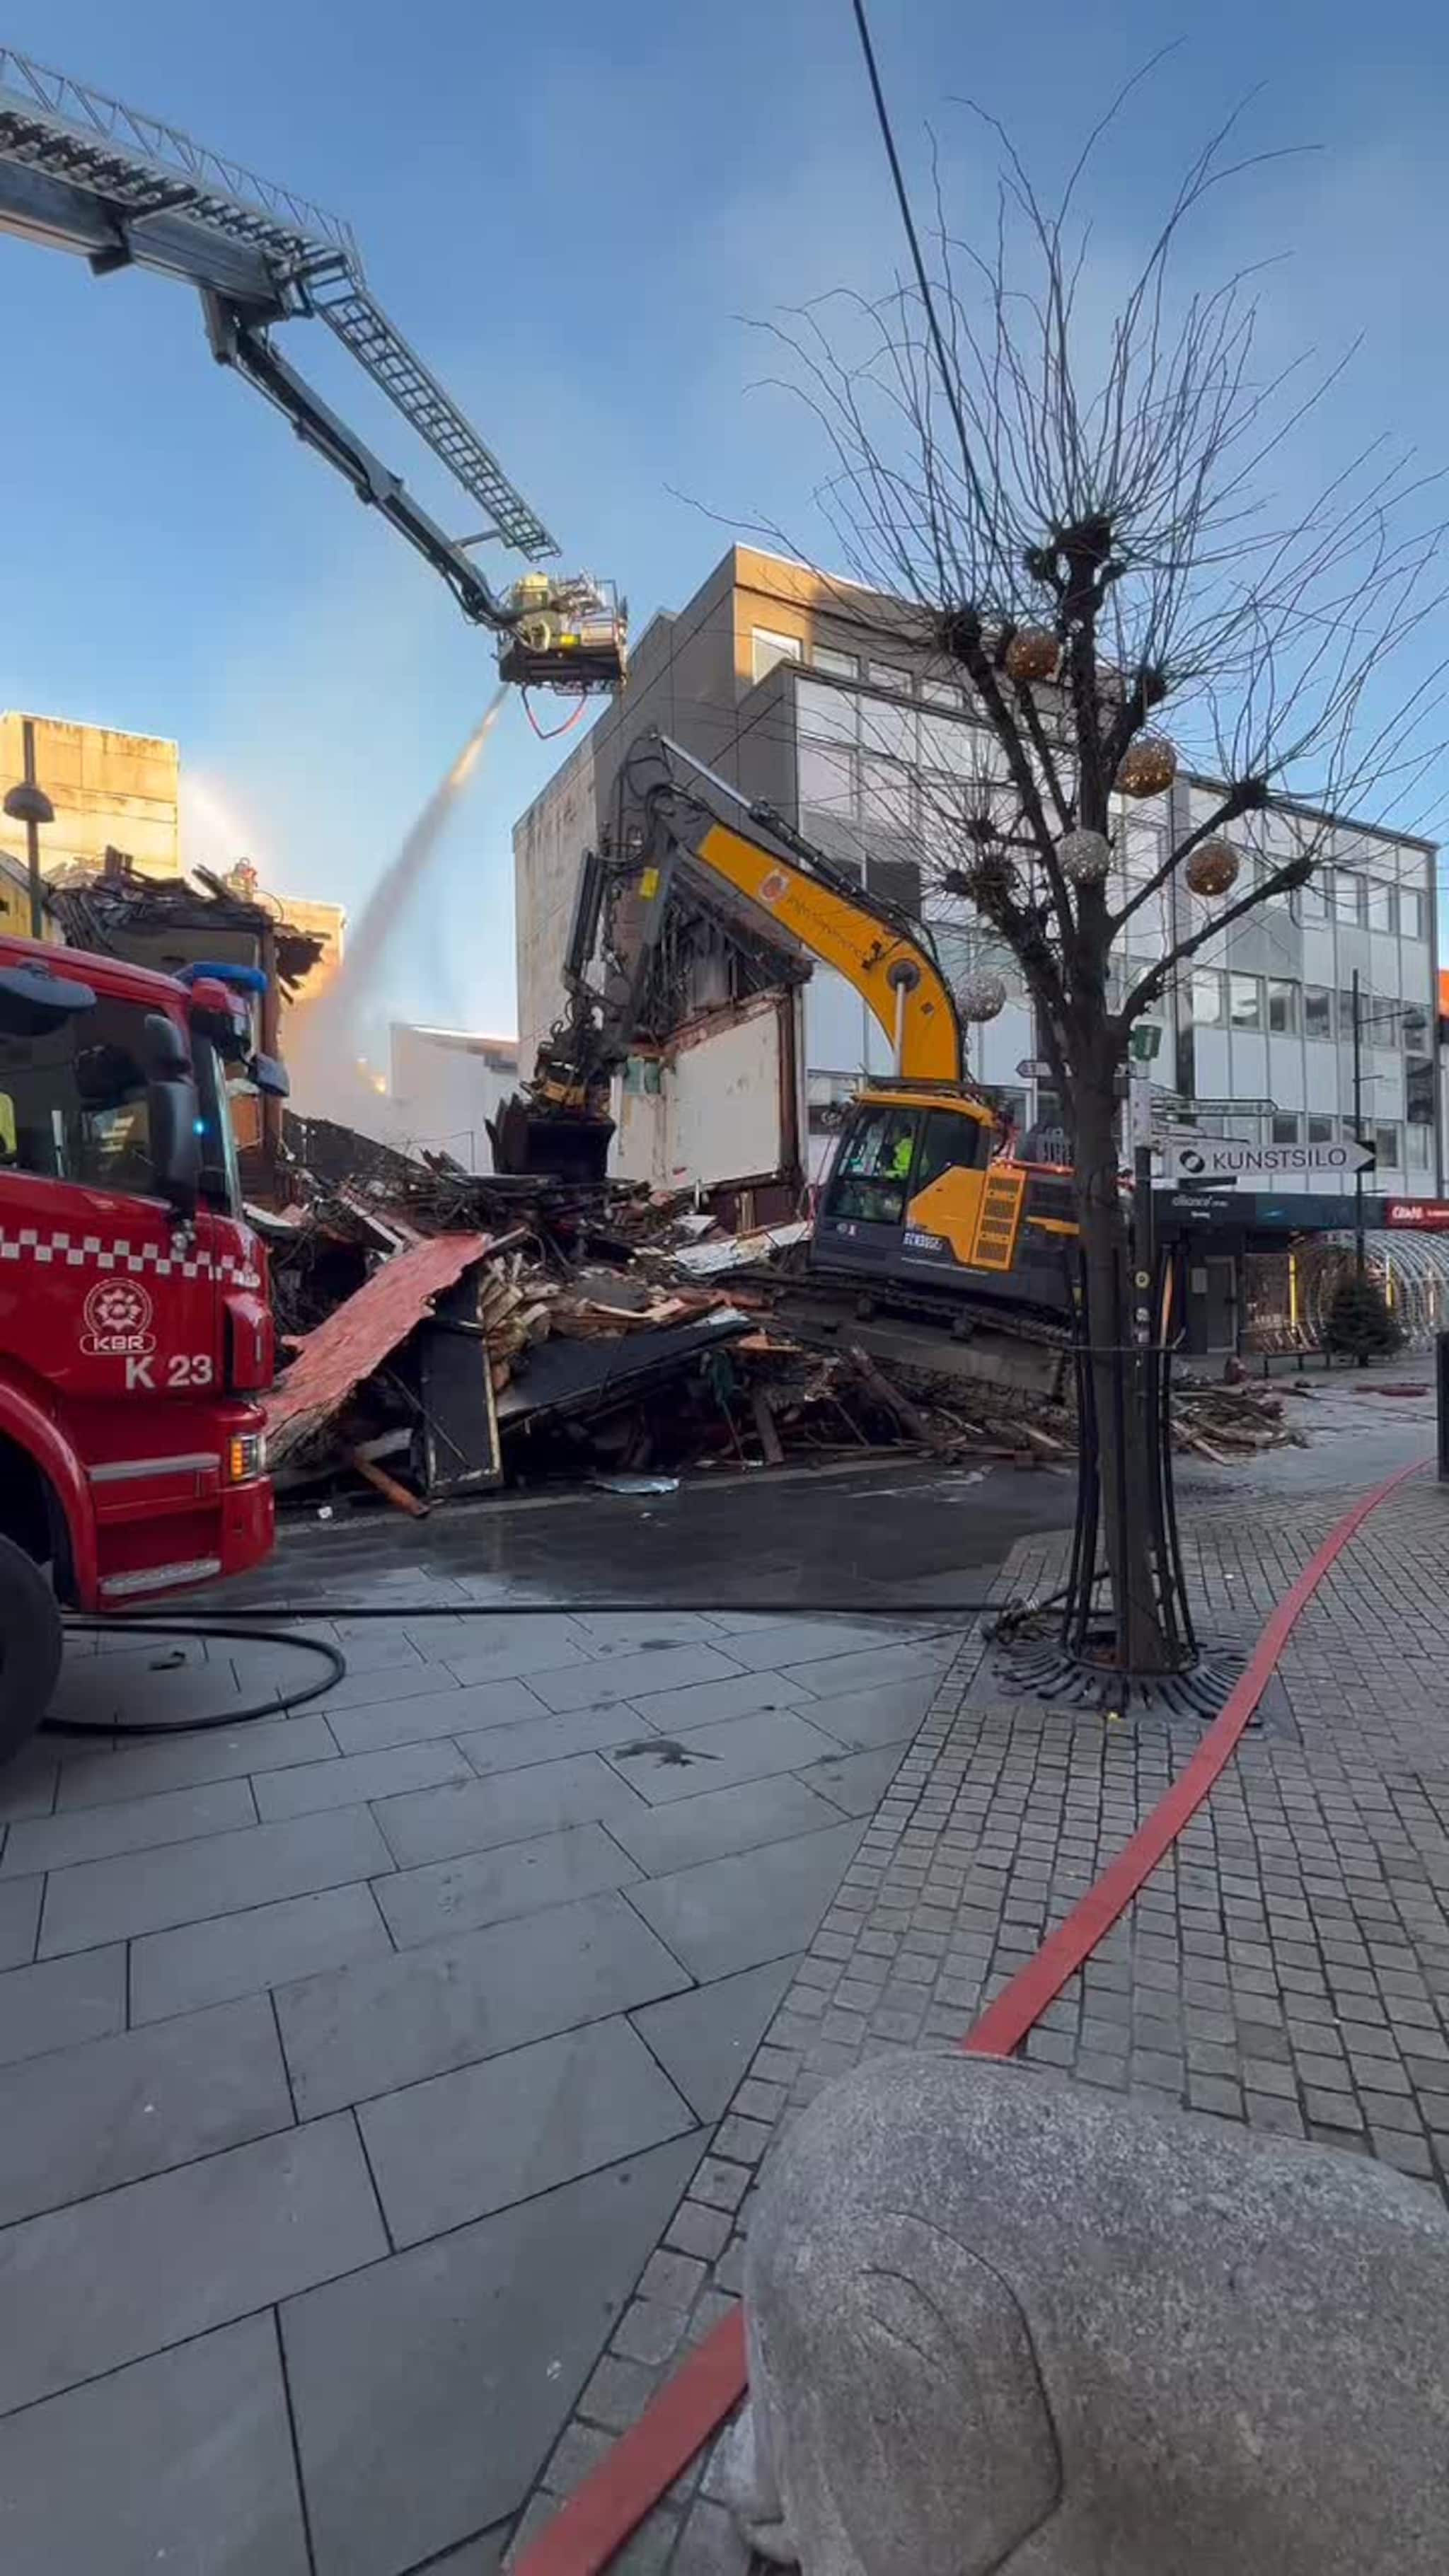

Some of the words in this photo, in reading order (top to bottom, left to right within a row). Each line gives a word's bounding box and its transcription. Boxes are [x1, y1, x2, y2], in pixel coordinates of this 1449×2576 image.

[1213, 1148, 1347, 1171] KUNSTSILO
[93, 1335, 144, 1351] KBR
[126, 1357, 155, 1390] K
[168, 1355, 212, 1387] 23
